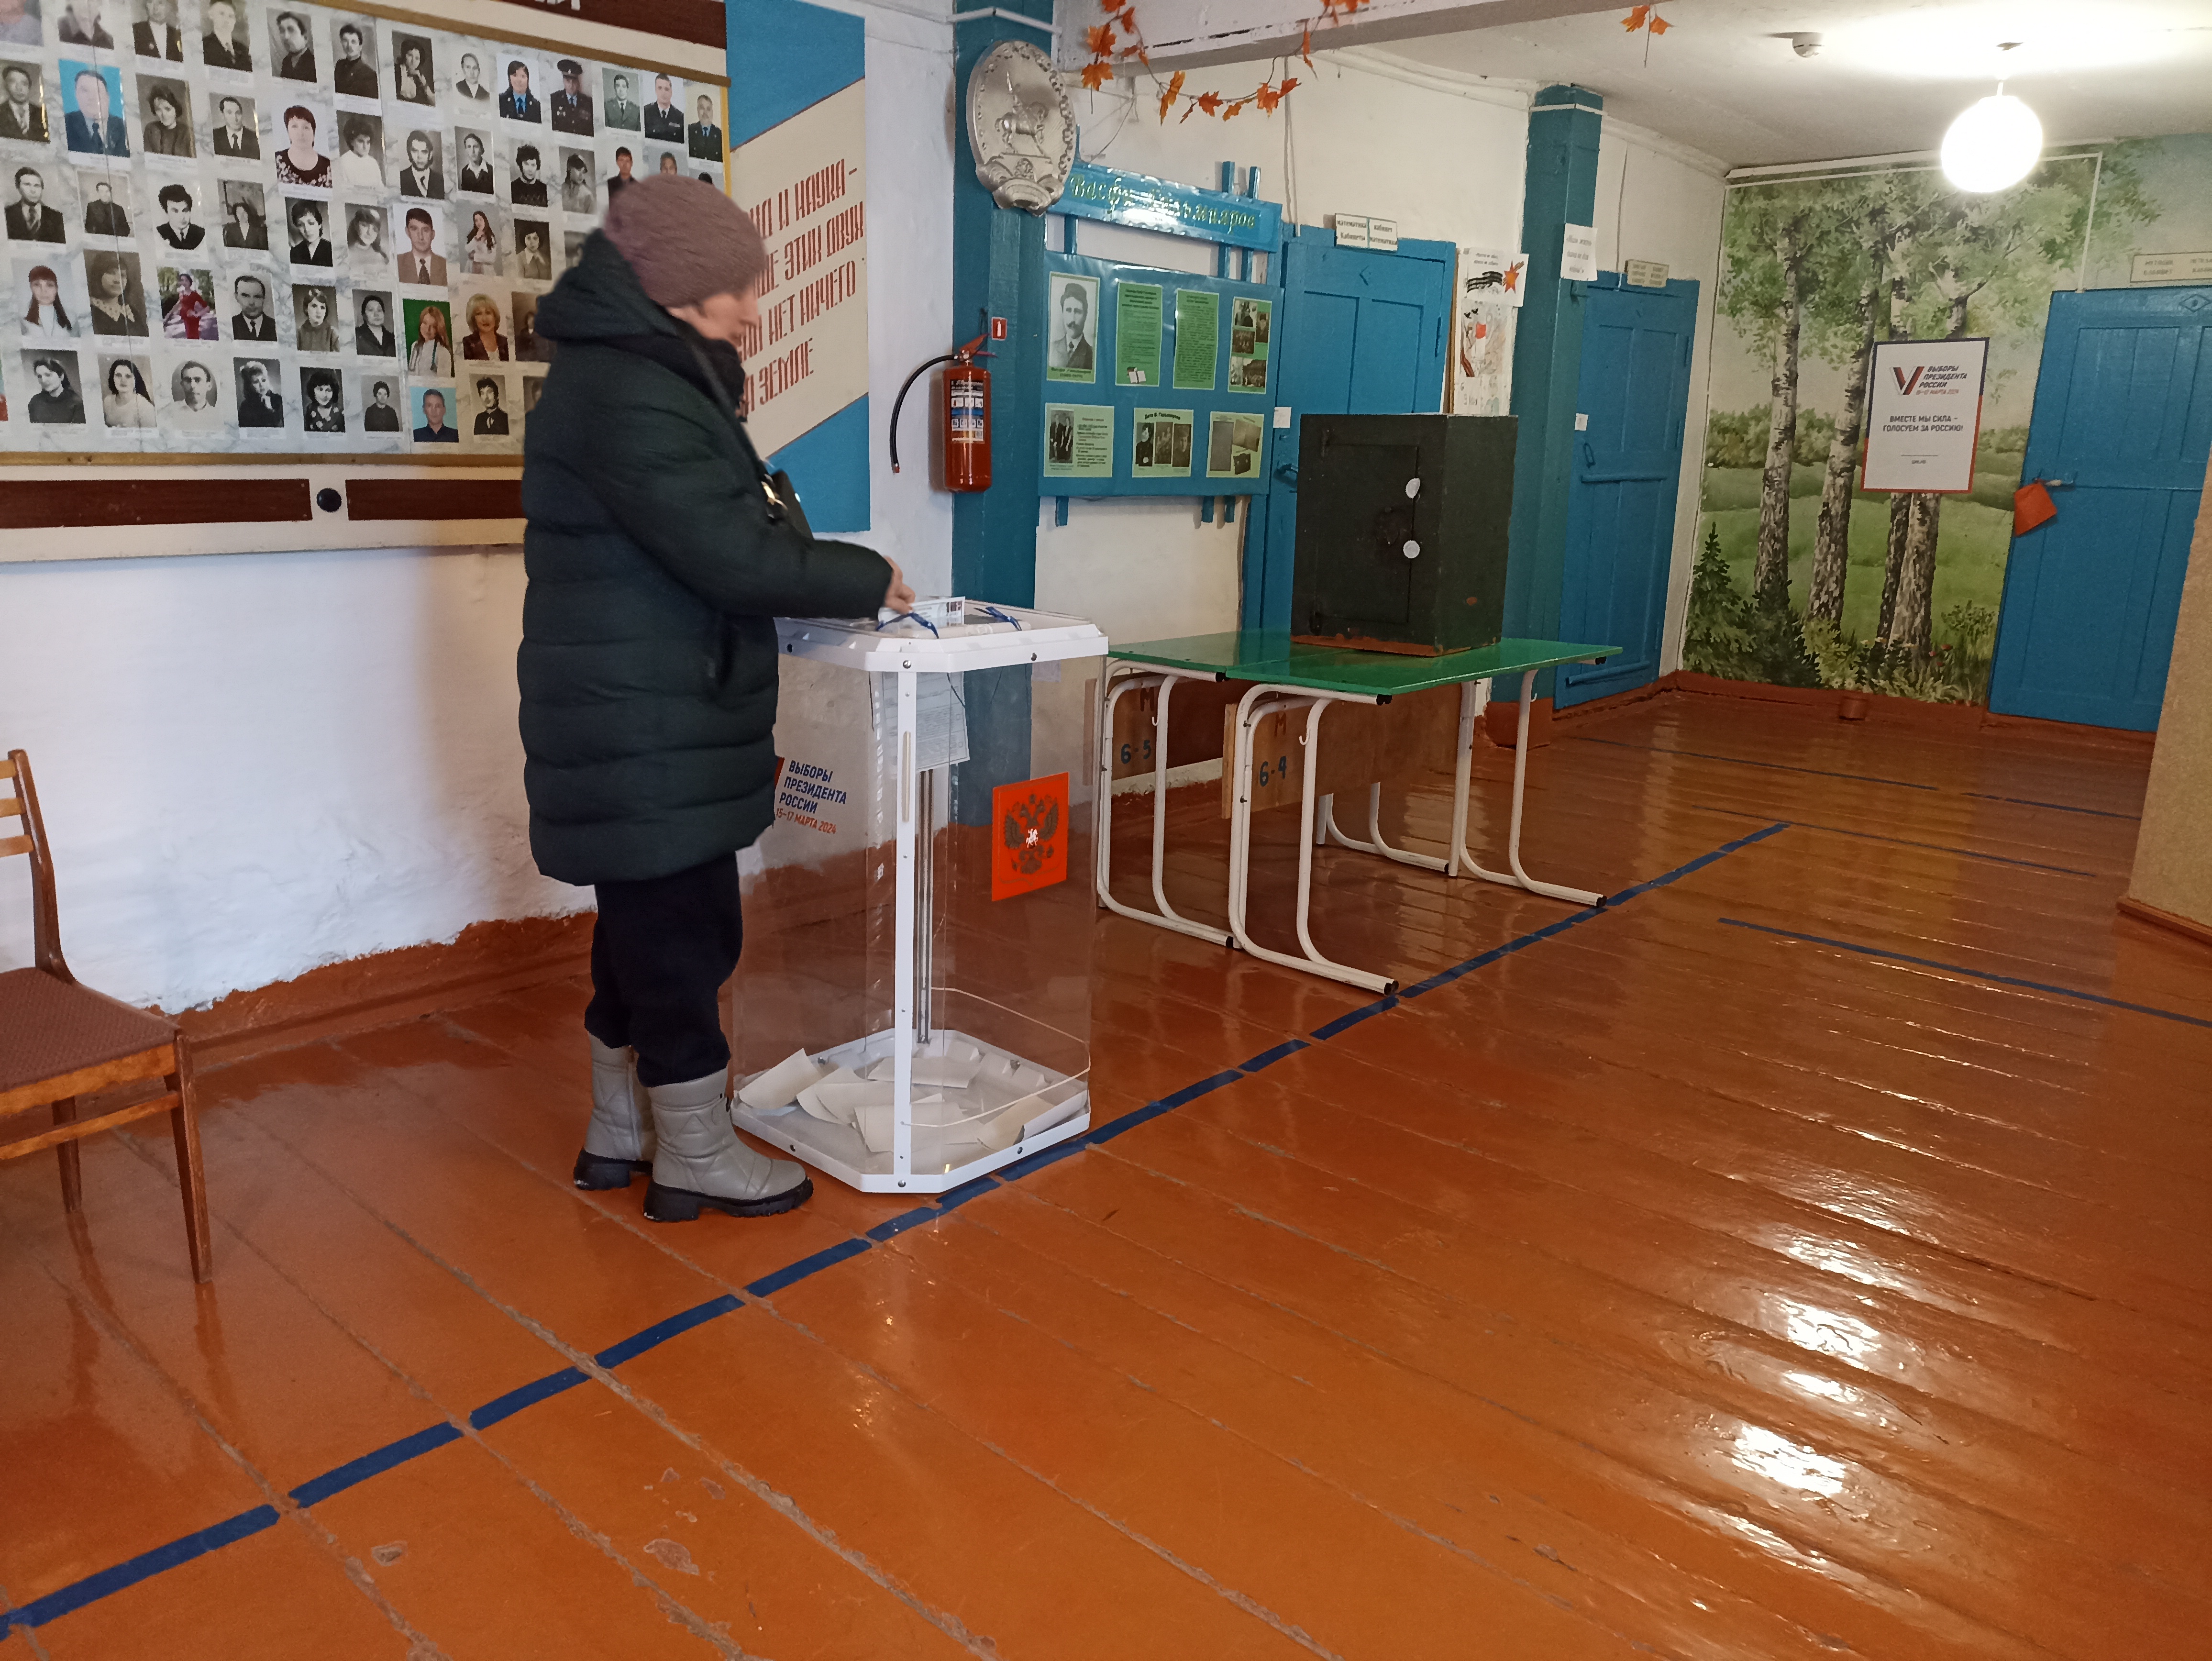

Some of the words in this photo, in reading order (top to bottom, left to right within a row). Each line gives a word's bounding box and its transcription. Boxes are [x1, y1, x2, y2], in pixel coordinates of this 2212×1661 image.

[778, 189, 789, 231] И
[795, 158, 845, 221] НАУКА
[785, 225, 822, 280] ЭТИХ
[826, 201, 863, 257] ДВУХ
[768, 294, 795, 345] НЕТ
[800, 260, 855, 326] НИЧЕГО
[759, 337, 814, 405] ЗЕМЛЕ
[784, 776, 847, 804] ПРЕЗИДЕНТА
[788, 760, 833, 783] ВЫБОРЫ
[779, 792, 818, 814] РОССИИ
[794, 814, 818, 829] МАРТА
[818, 821, 837, 834] 2024
